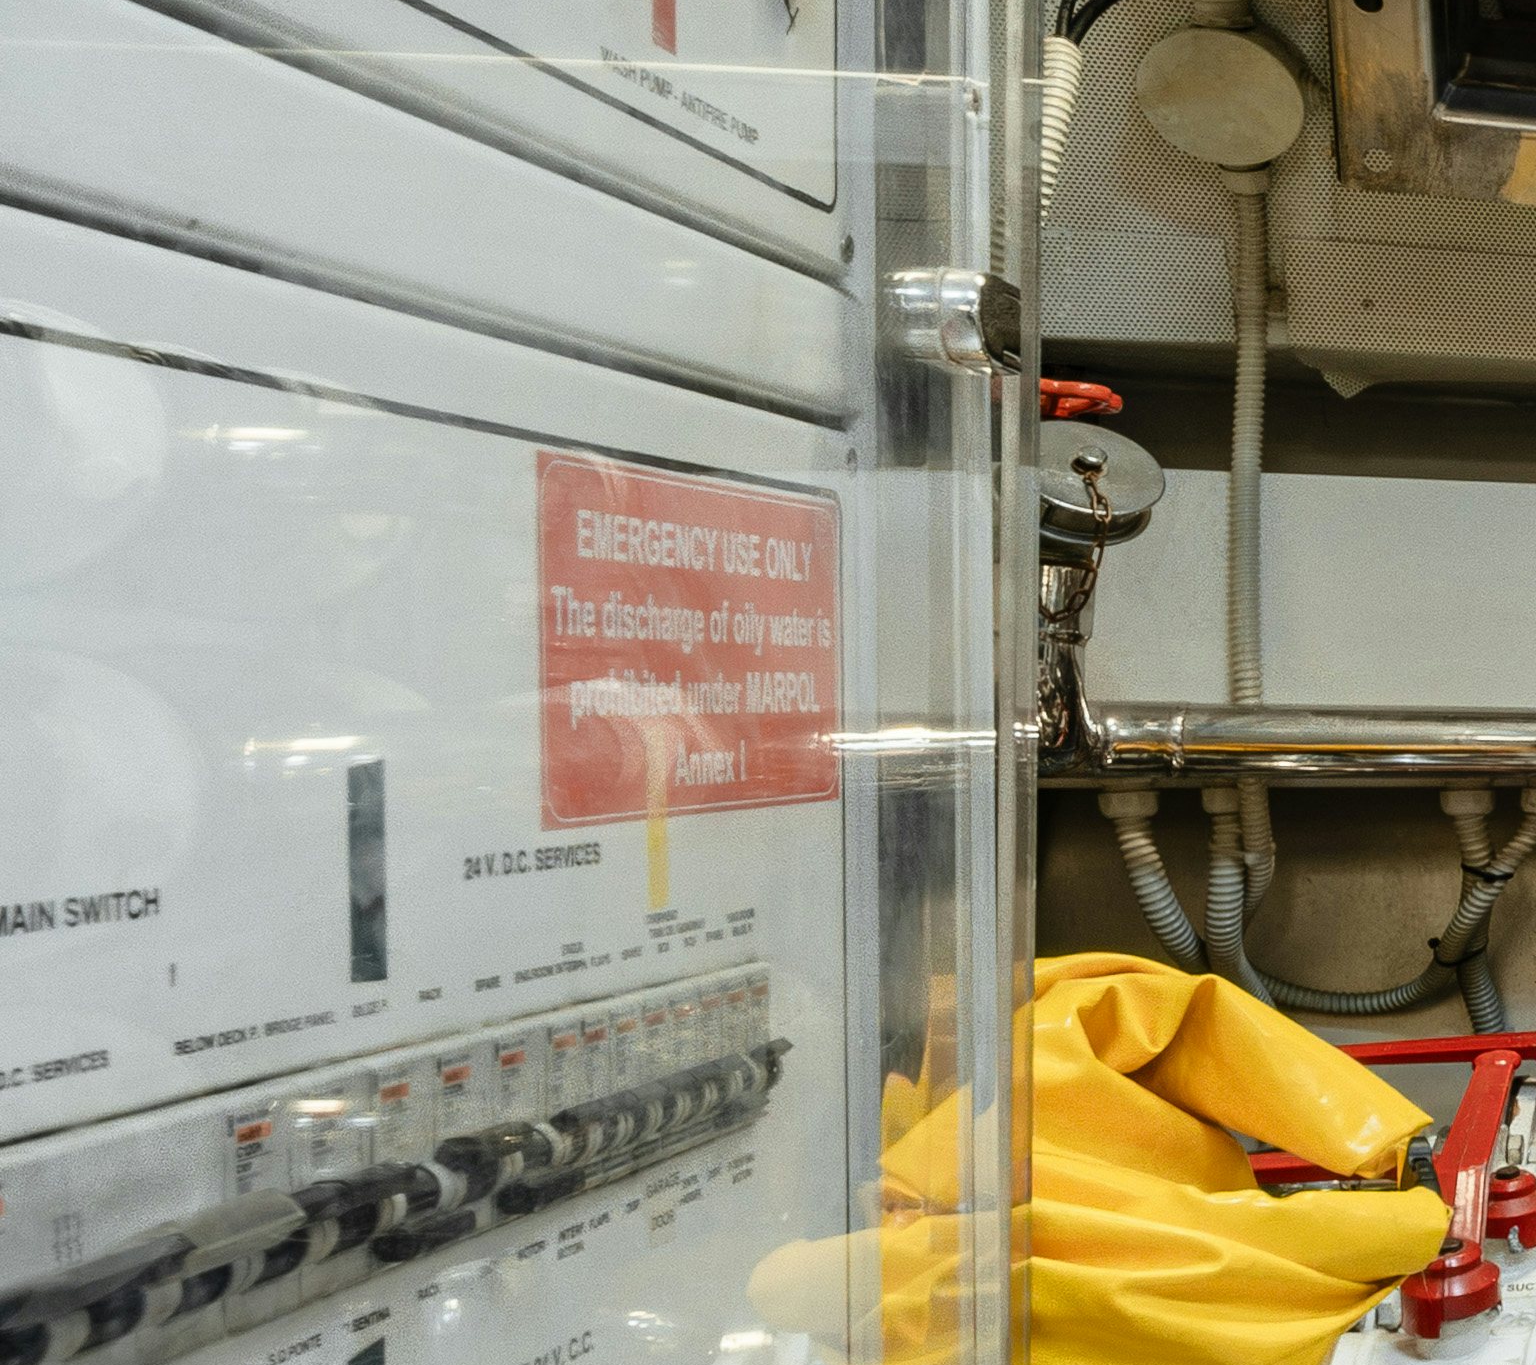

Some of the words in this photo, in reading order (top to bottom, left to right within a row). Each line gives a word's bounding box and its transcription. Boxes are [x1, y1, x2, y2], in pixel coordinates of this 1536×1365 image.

[639, 67, 674, 106] PUMP
[576, 508, 719, 572] EMERGENCY
[721, 532, 762, 577] USE
[765, 538, 814, 582] ONLY
[550, 585, 597, 637] The
[600, 589, 706, 655] discharge
[709, 600, 729, 644] of
[732, 602, 766, 656] oily
[768, 608, 813, 648] water
[814, 615, 833, 648] is
[569, 668, 683, 731] prohibited
[685, 671, 741, 717] under
[744, 671, 821, 716] MARPOL
[673, 742, 737, 788] Annex
[461, 854, 483, 882] 24
[501, 848, 532, 877] D.C.
[534, 841, 601, 872] SERVICES
[64, 888, 160, 928] SWITCH
[31, 1048, 110, 1084] SERVICES
[568, 1329, 596, 1362] C.C.
